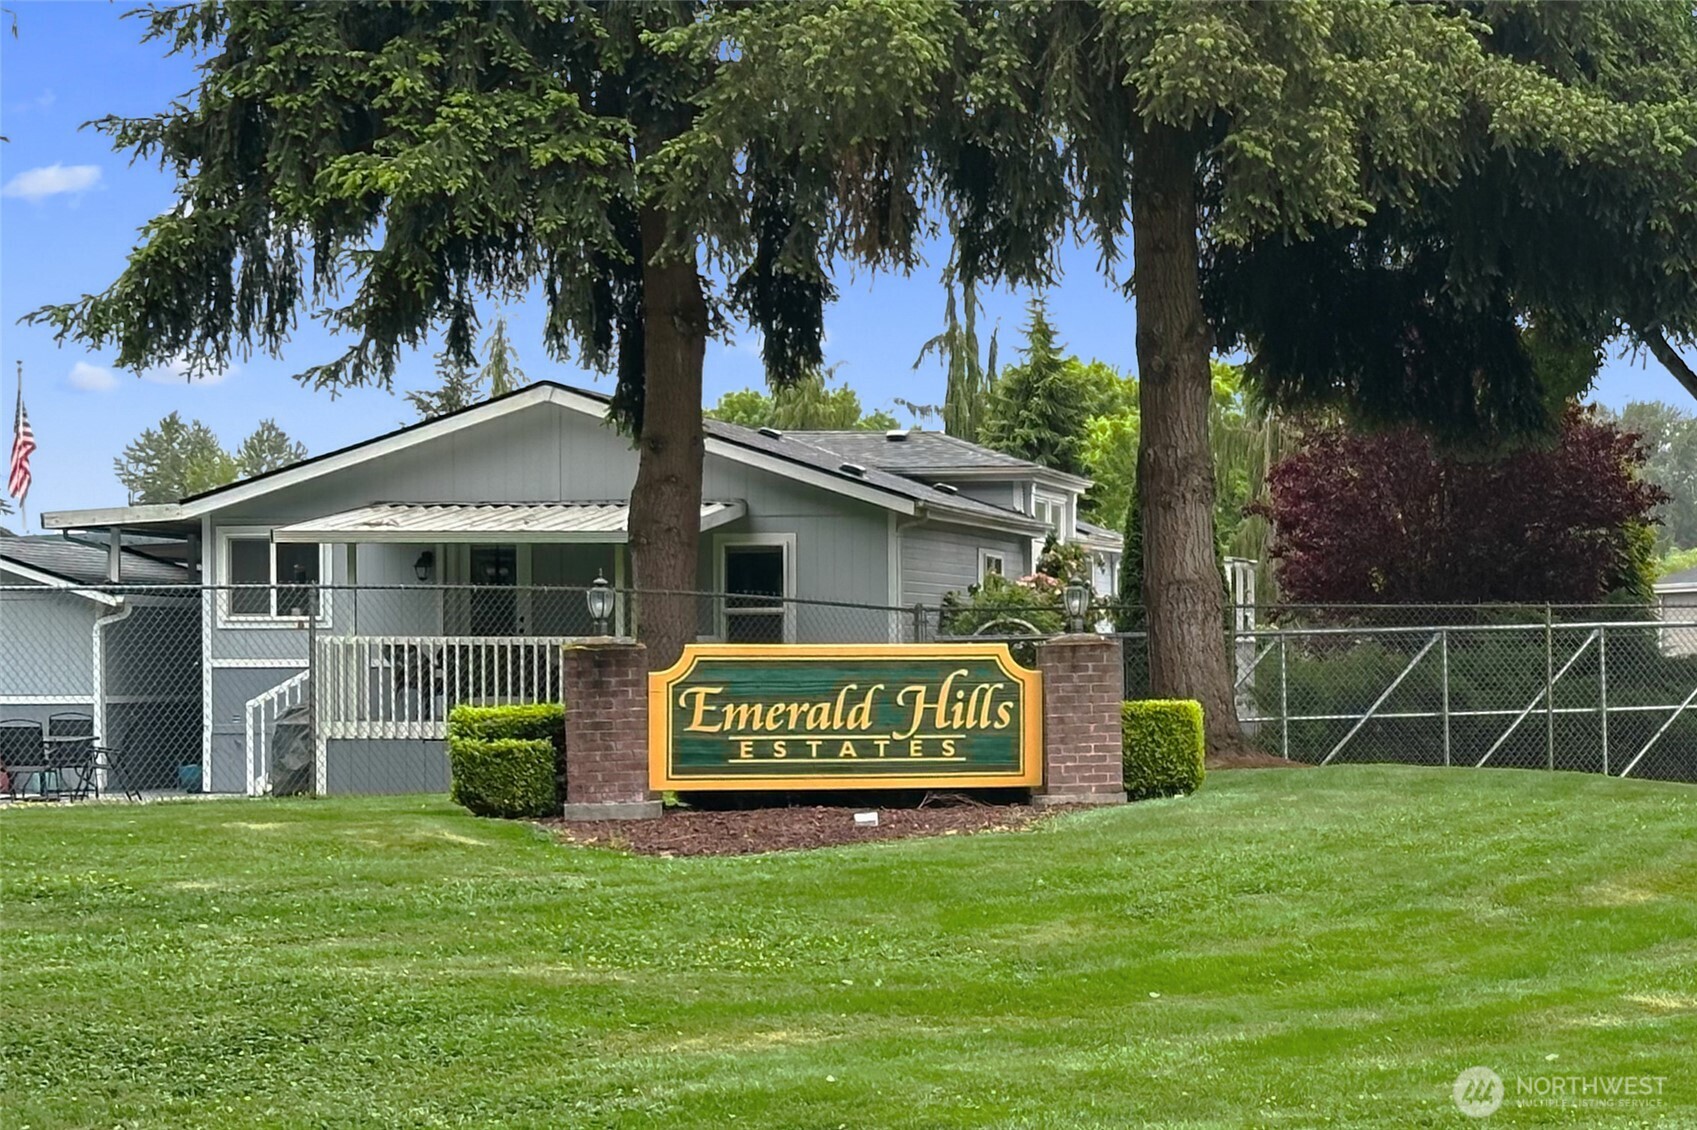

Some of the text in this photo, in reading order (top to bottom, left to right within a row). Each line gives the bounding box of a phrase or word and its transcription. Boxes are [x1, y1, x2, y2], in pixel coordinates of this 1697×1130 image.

[678, 668, 1014, 741] Emerald Hills
[740, 739, 956, 759] ESTATES
